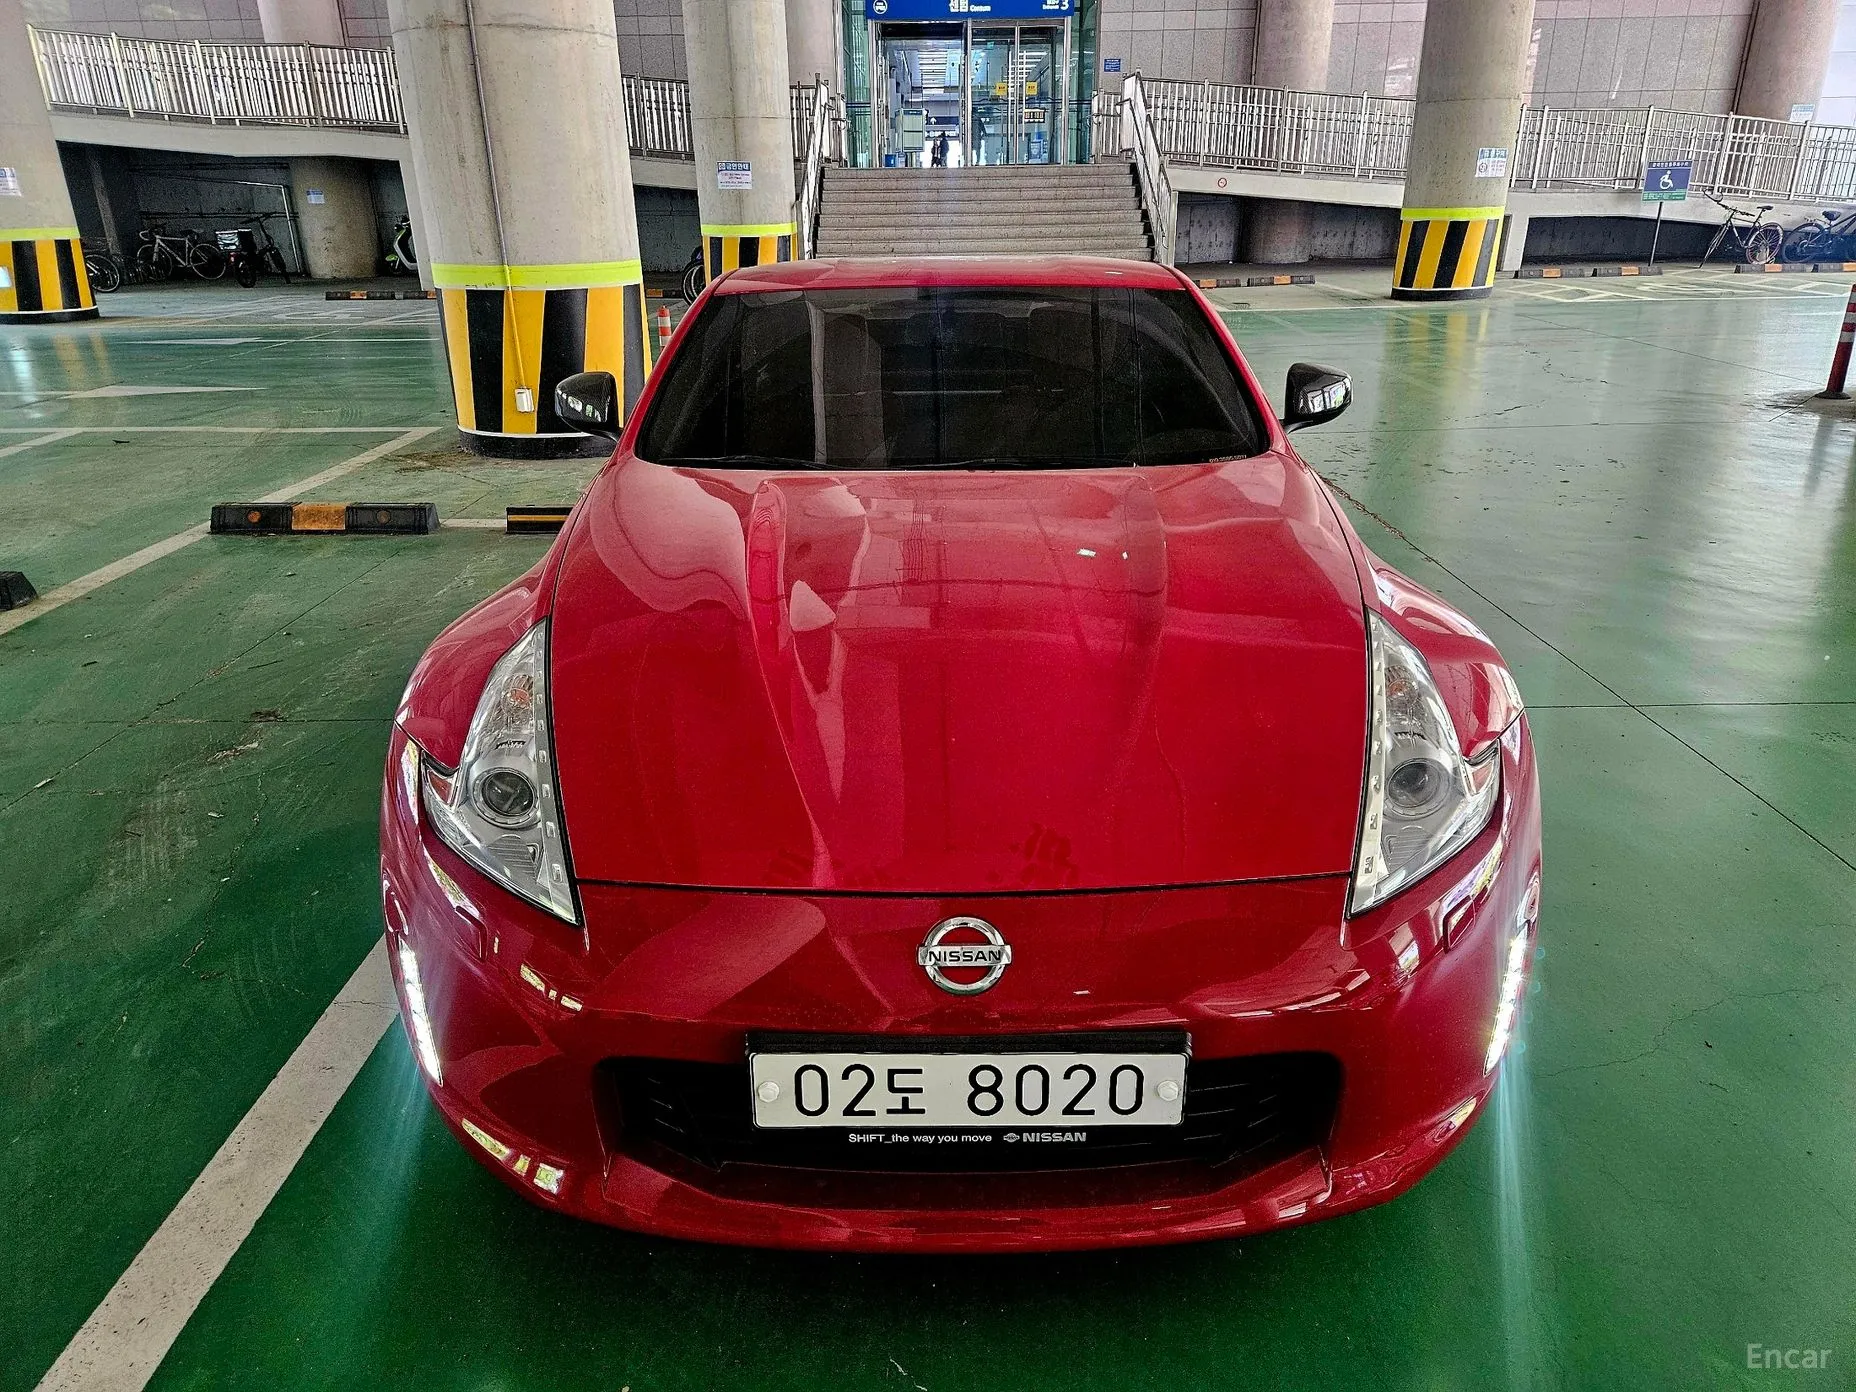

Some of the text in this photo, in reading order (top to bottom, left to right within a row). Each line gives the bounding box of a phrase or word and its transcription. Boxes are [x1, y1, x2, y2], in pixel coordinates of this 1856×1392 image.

[928, 950, 1001, 962] NISSAN
[794, 1064, 1145, 1117] 02도 8020
[913, 1135, 935, 1144] way
[938, 1135, 958, 1144] you
[962, 1135, 992, 1143] move
[1023, 1133, 1087, 1142] NISSAN
